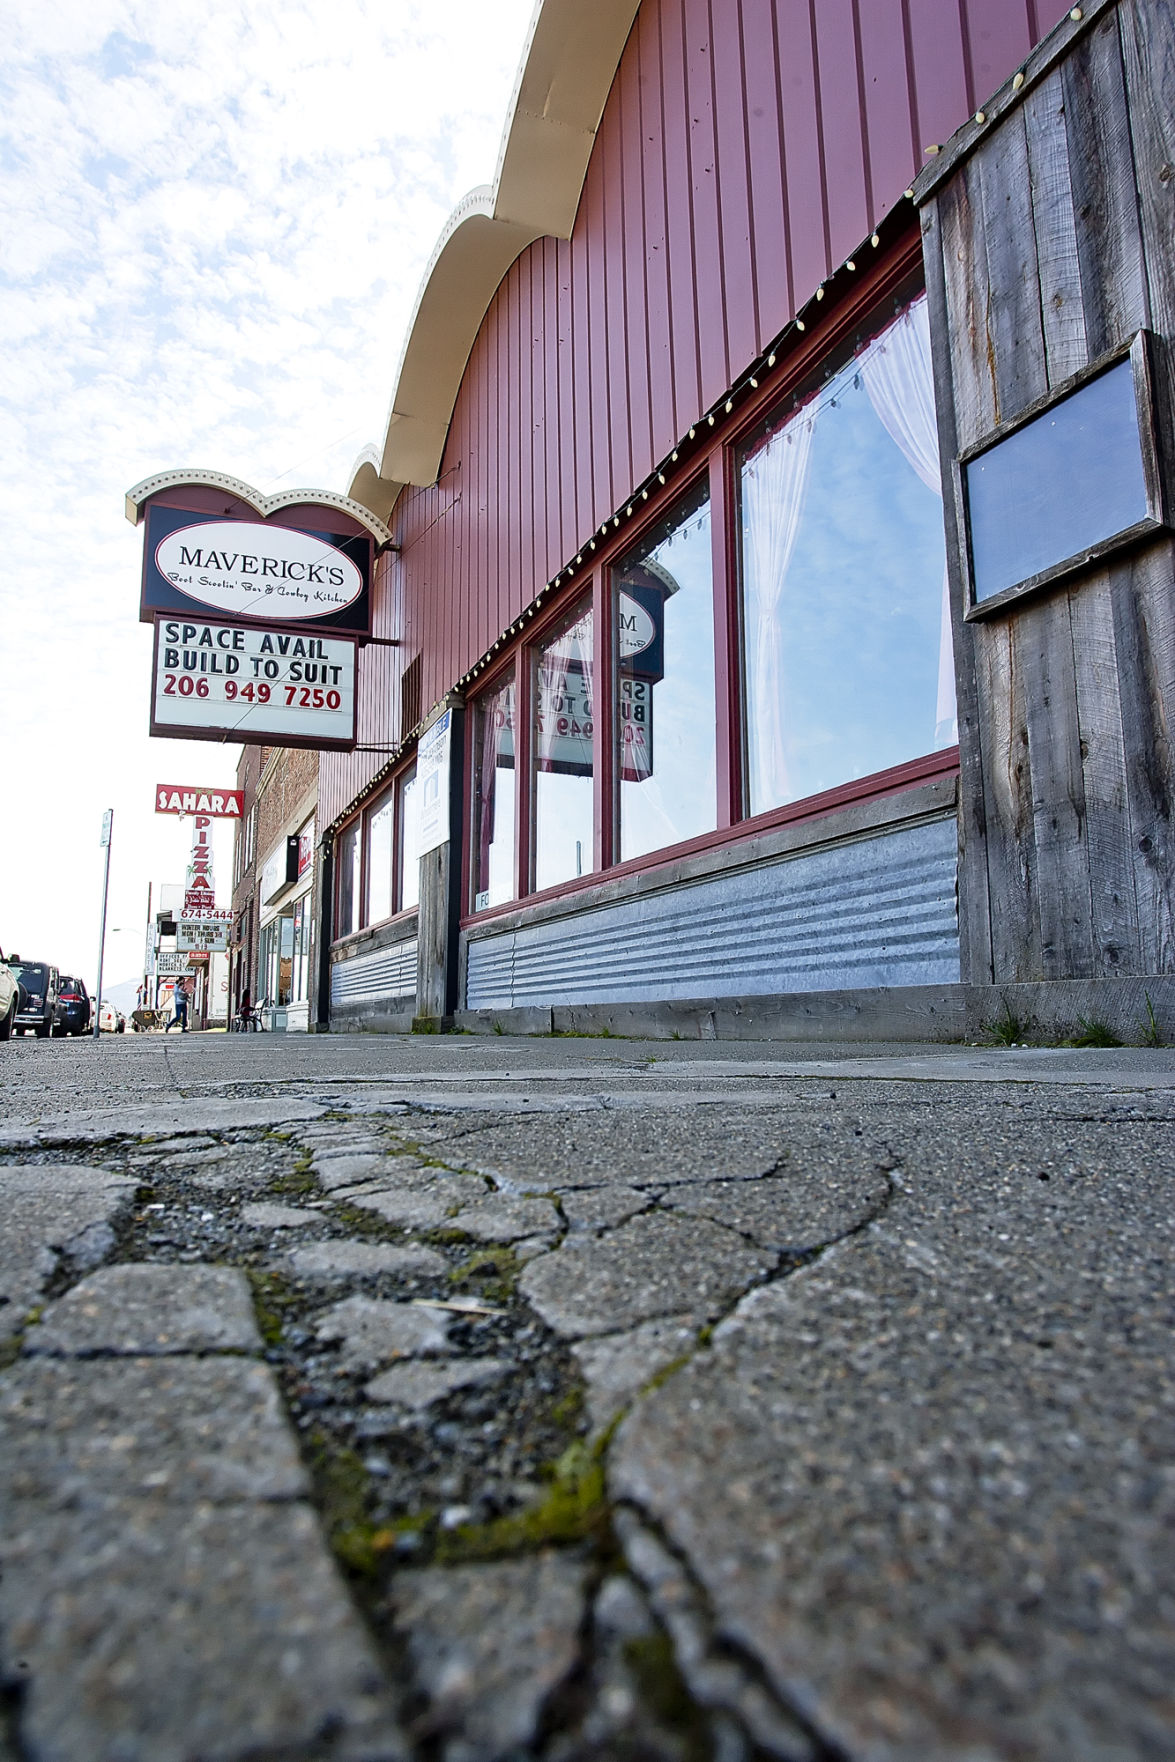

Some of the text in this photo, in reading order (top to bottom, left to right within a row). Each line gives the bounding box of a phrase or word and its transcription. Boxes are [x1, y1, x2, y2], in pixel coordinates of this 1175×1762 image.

[178, 546, 345, 586] MAVERICK'S
[167, 572, 348, 604] Boot Scootin' Bar & Cowboy Kitchen
[165, 623, 328, 660] SPACE AVAIL
[164, 648, 343, 686] BUILD TO SUIT
[163, 674, 341, 710] 206 949 7250
[158, 791, 240, 814] SAHARA
[191, 816, 211, 889] PIZZA
